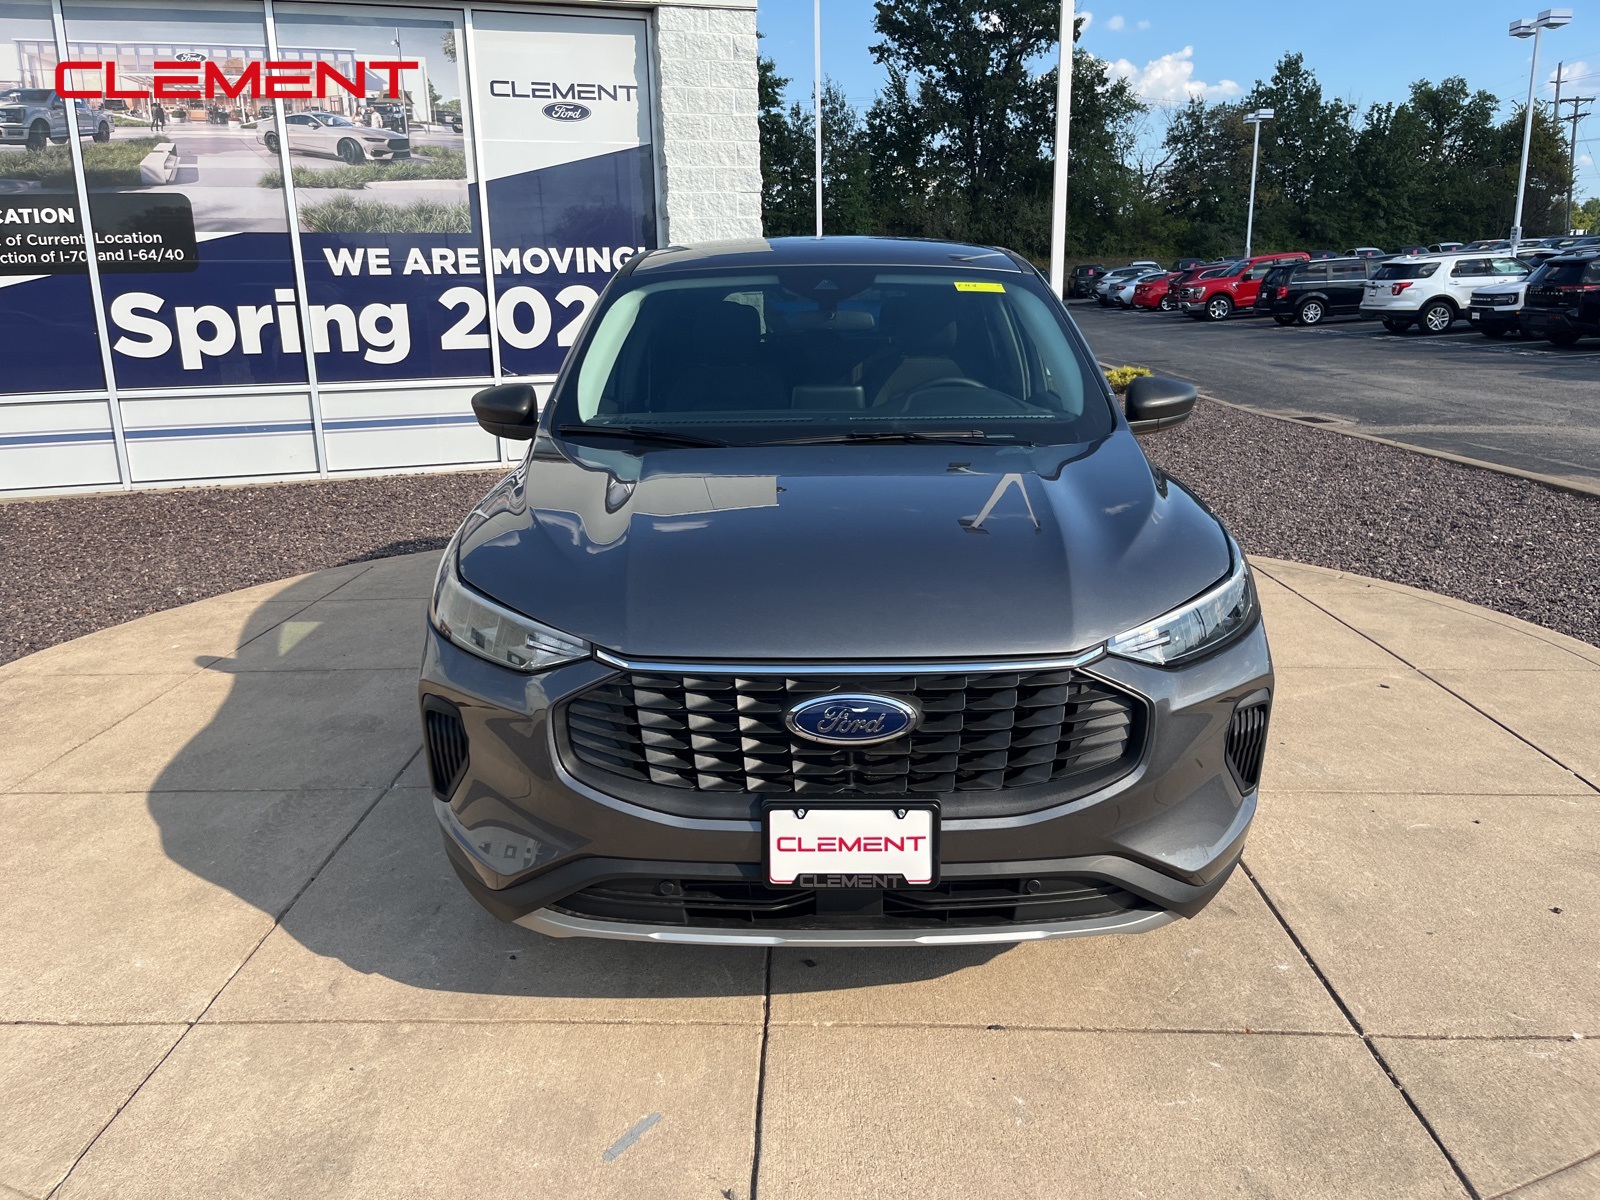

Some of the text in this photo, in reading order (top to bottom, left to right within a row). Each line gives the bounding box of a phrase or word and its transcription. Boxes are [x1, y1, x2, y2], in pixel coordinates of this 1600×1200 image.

[490, 80, 638, 102] CLEMENT
[0, 208, 75, 225] ATION
[6, 233, 22, 246] of
[27, 233, 86, 246] Current
[95, 231, 163, 244] Location
[0, 247, 184, 264] ction of I-70 and I-64/40
[323, 247, 392, 276] WE
[403, 247, 481, 275] ARE
[110, 288, 411, 370] Spring
[816, 706, 887, 734] Ford
[776, 835, 927, 852] CLEMENT
[800, 873, 903, 889] CLEMENT
